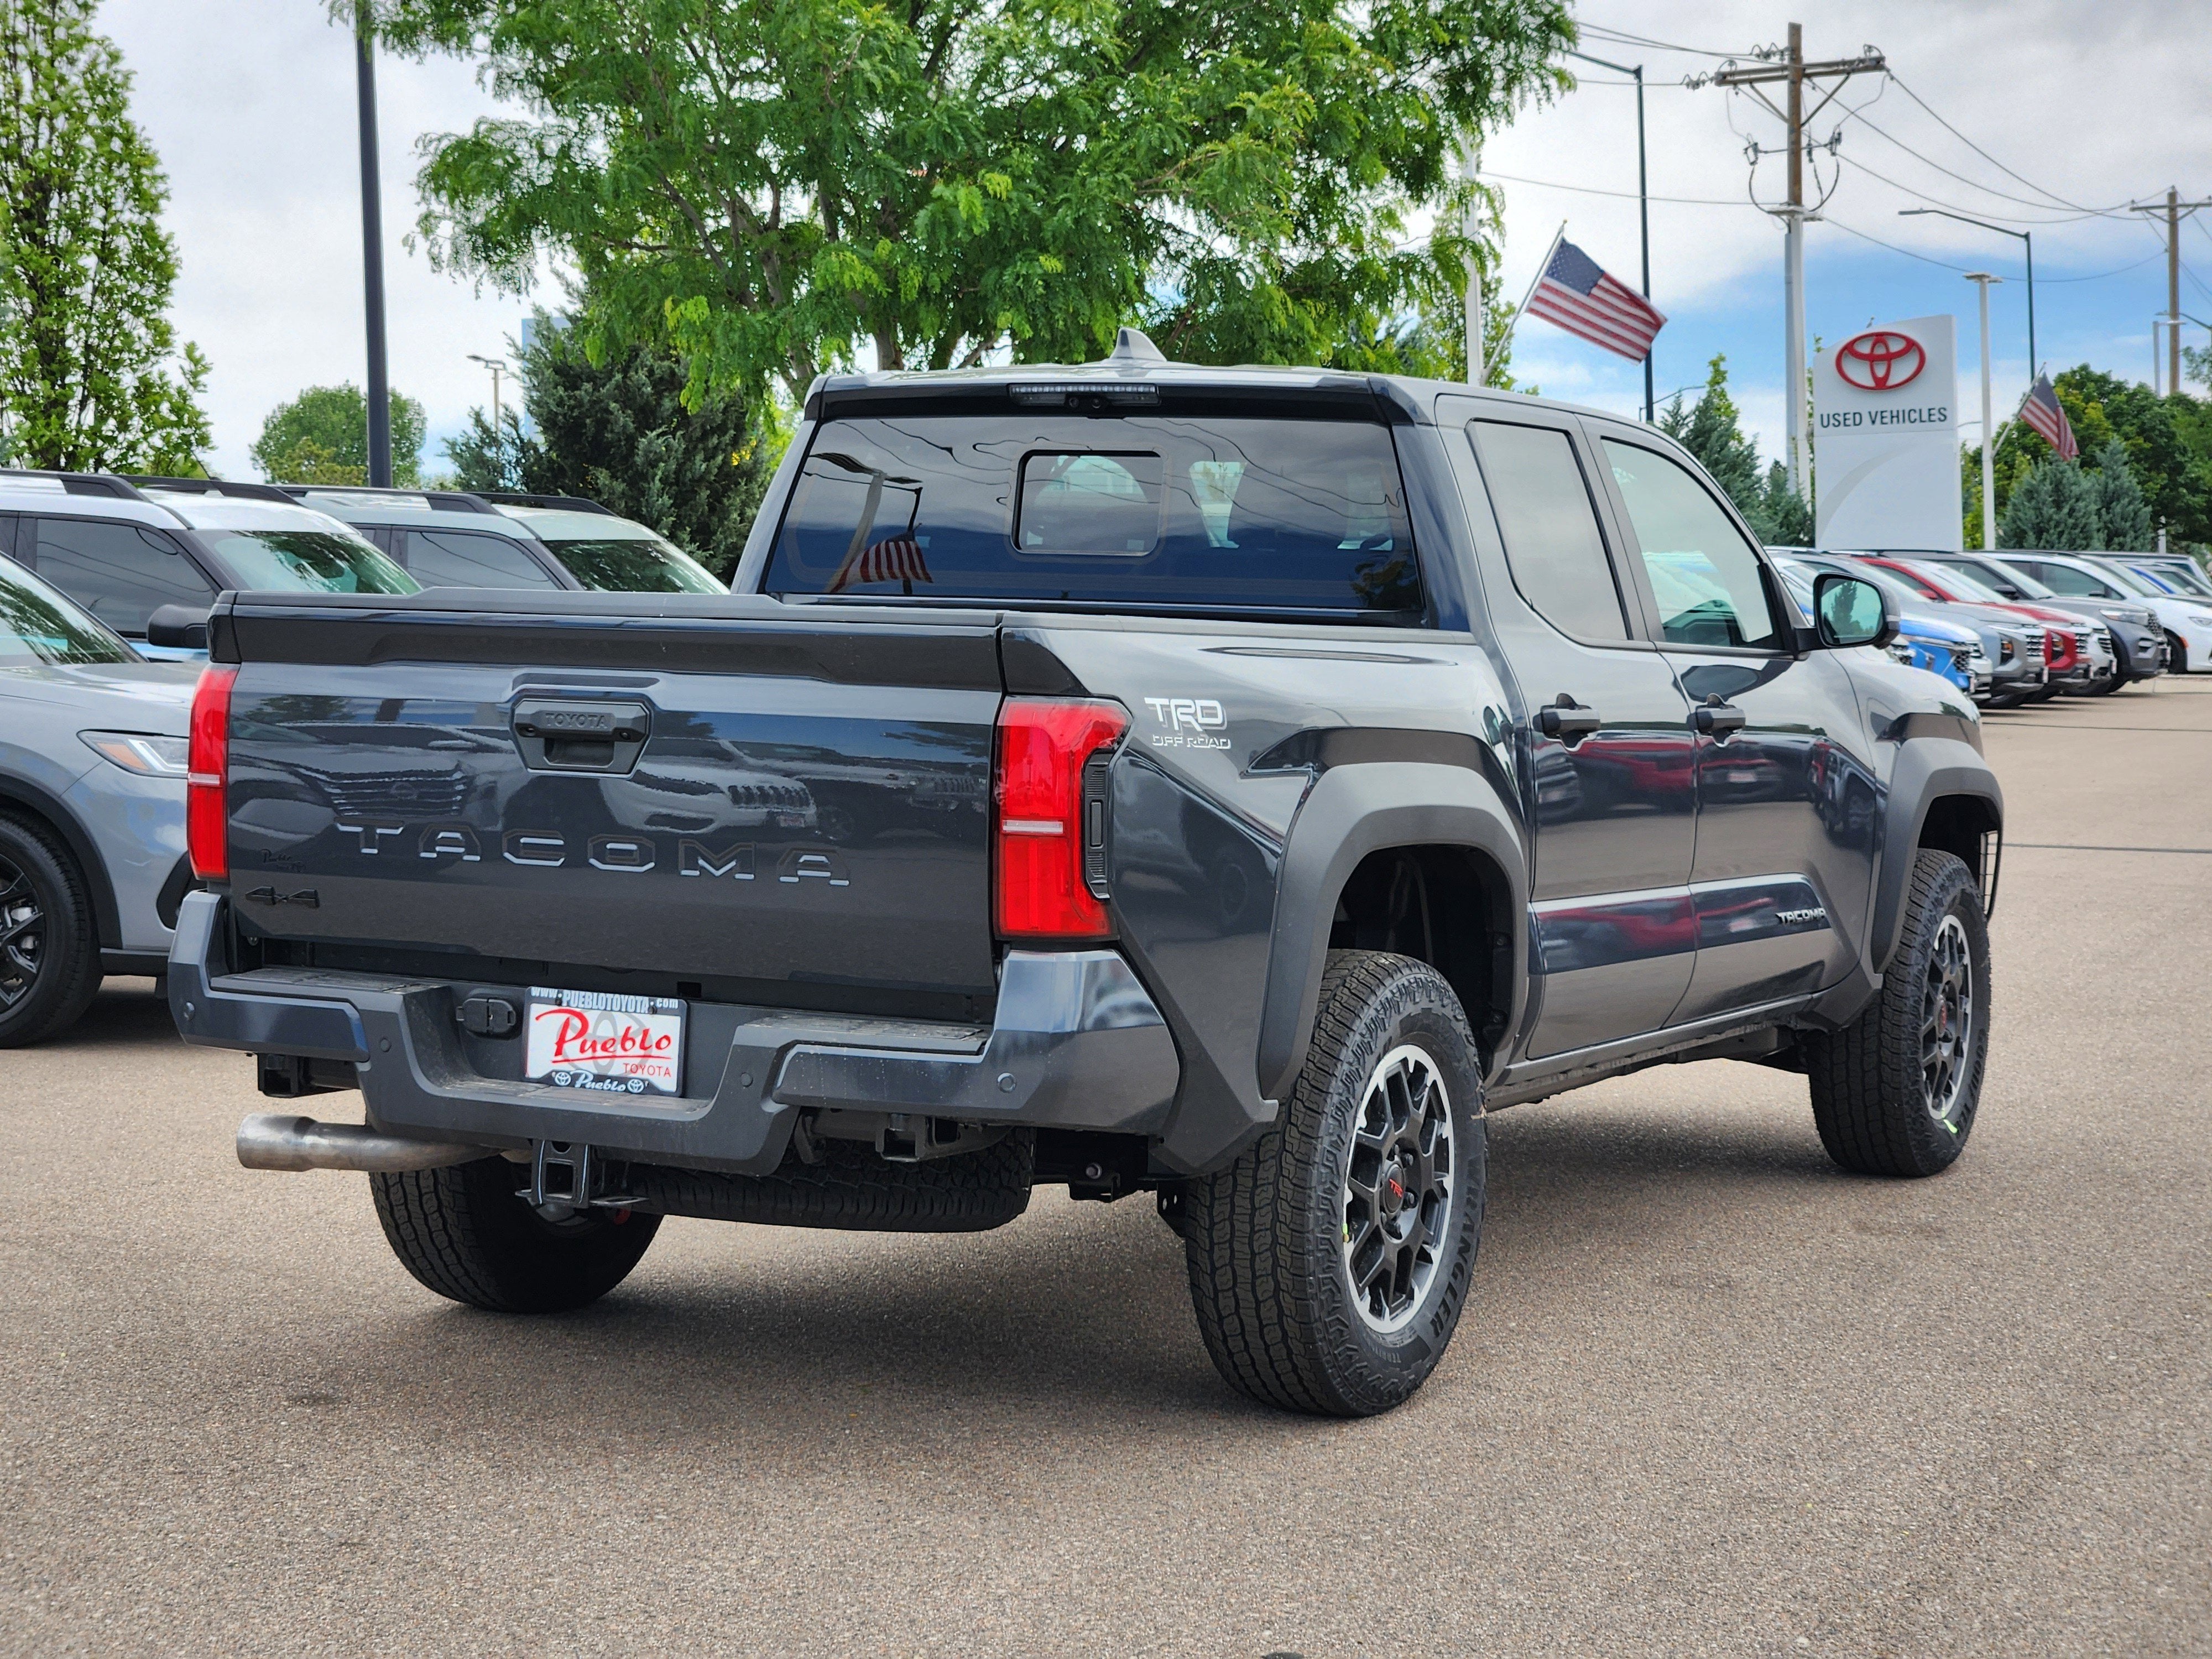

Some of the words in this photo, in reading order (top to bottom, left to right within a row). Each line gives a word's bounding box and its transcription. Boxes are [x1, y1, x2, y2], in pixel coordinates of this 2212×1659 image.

[1820, 412, 1863, 429] USED
[1868, 407, 1948, 426] VEHICLES
[545, 713, 608, 729] TOYOTA
[1144, 697, 1224, 732] TRD
[1152, 734, 1183, 747] OFF
[1187, 737, 1232, 749] ROAD
[333, 816, 850, 886] TACOMA
[1775, 907, 1826, 924] TACOMA
[535, 1008, 671, 1057] Pueblo
[570, 1070, 627, 1092] Pueblo
[623, 1062, 671, 1078] TOYOTA
